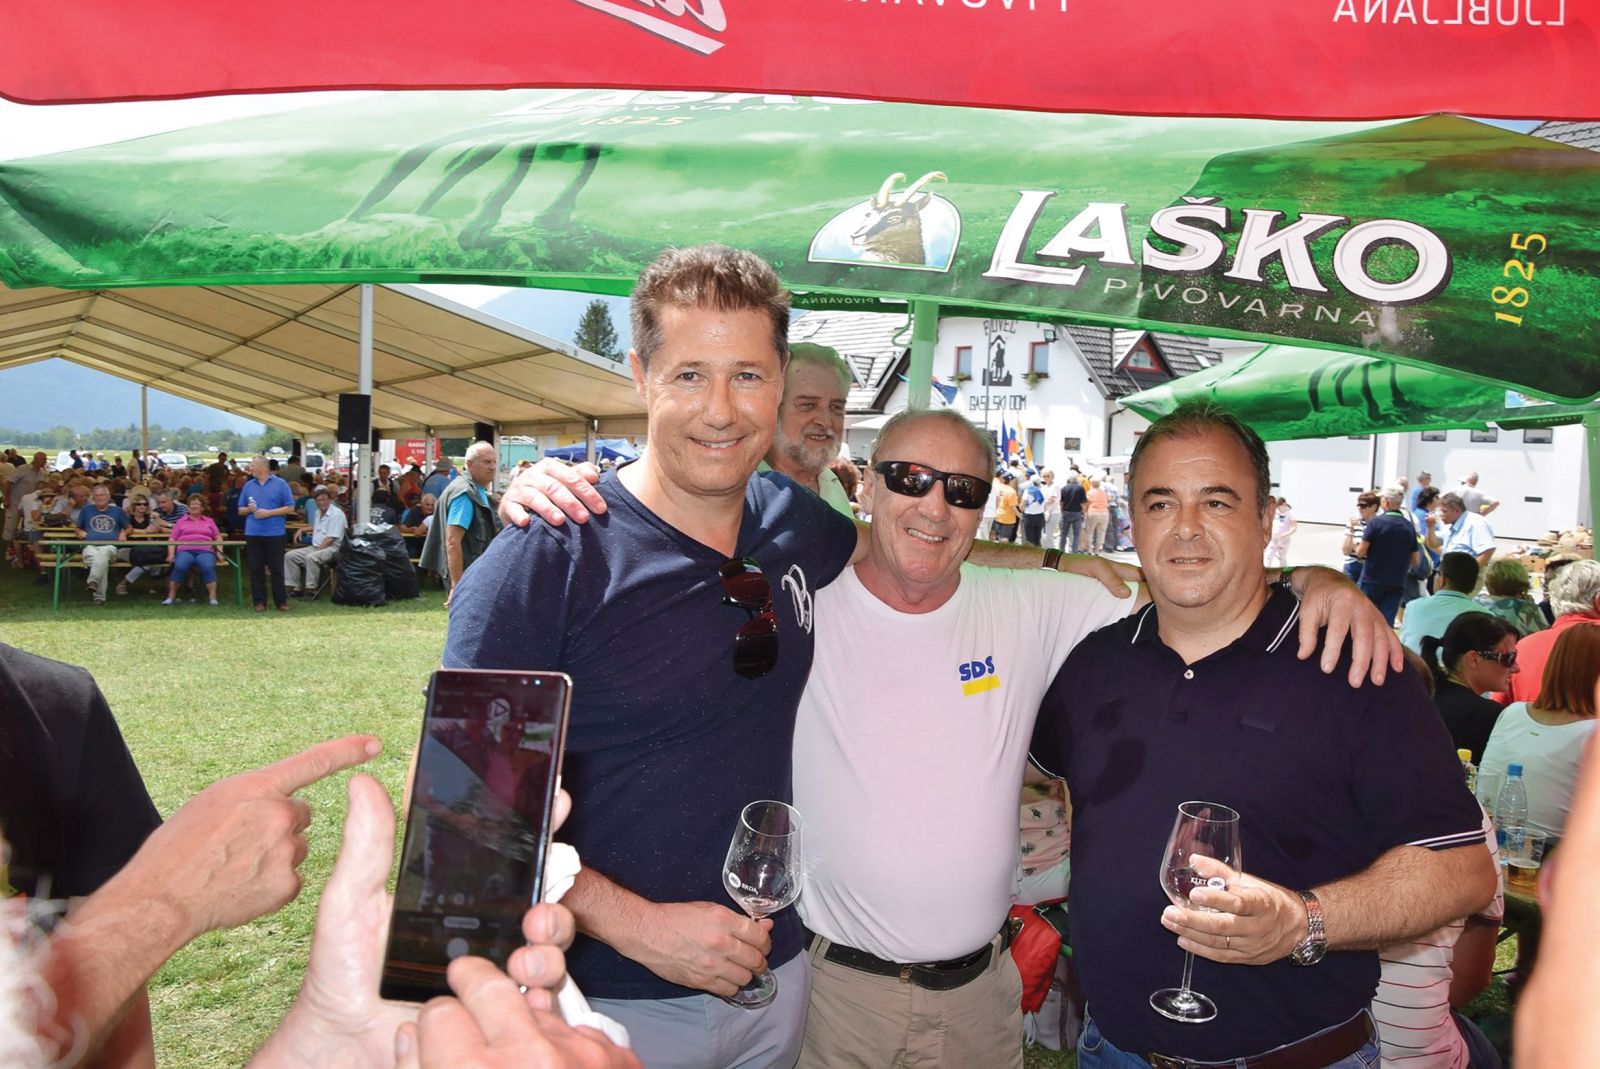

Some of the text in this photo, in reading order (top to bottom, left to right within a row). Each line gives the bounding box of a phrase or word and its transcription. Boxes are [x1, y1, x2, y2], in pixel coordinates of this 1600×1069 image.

[981, 190, 1454, 303] LAŠKO
[1103, 278, 1377, 328] PIVOVARNA
[1492, 233, 1547, 327] 1825
[959, 655, 995, 681] SDS
[1190, 877, 1208, 886] KLET
